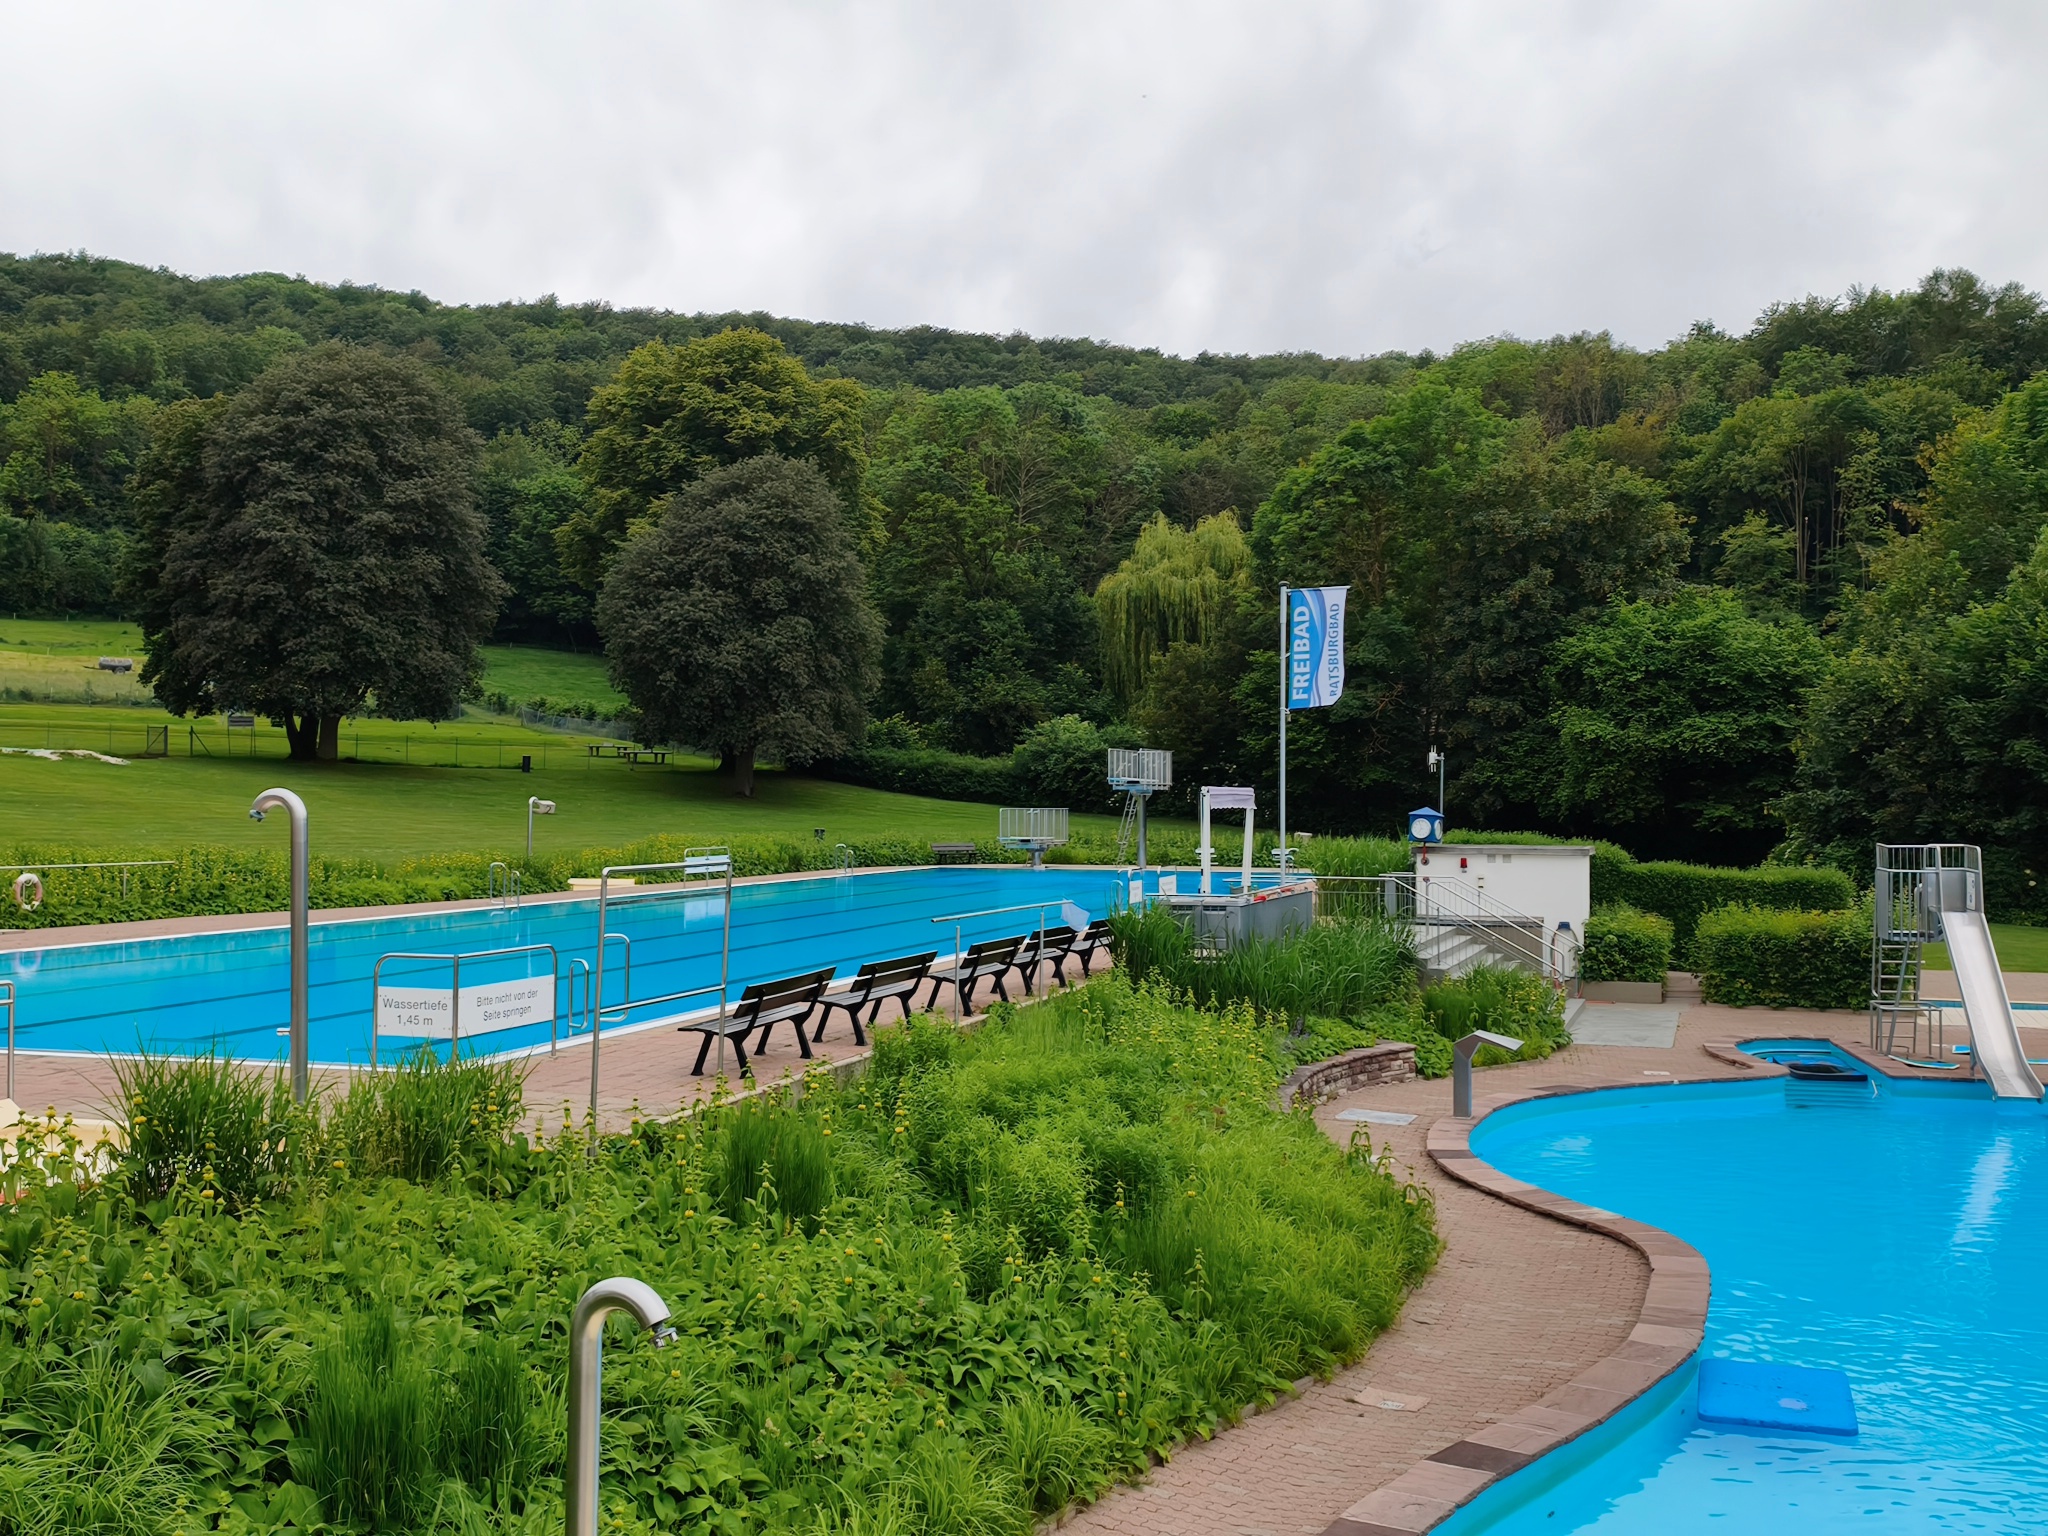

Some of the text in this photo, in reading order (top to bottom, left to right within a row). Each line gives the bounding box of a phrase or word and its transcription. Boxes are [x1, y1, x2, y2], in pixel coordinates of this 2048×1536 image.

[1293, 606, 1310, 700] FREIBAD
[1328, 603, 1340, 697] RATSBURGBAD
[382, 998, 448, 1011] Wassertiefe
[476, 989, 539, 1008] Bitte nicht von der
[397, 1015, 433, 1027] 1,45 m
[483, 1004, 532, 1021] Seite springen
